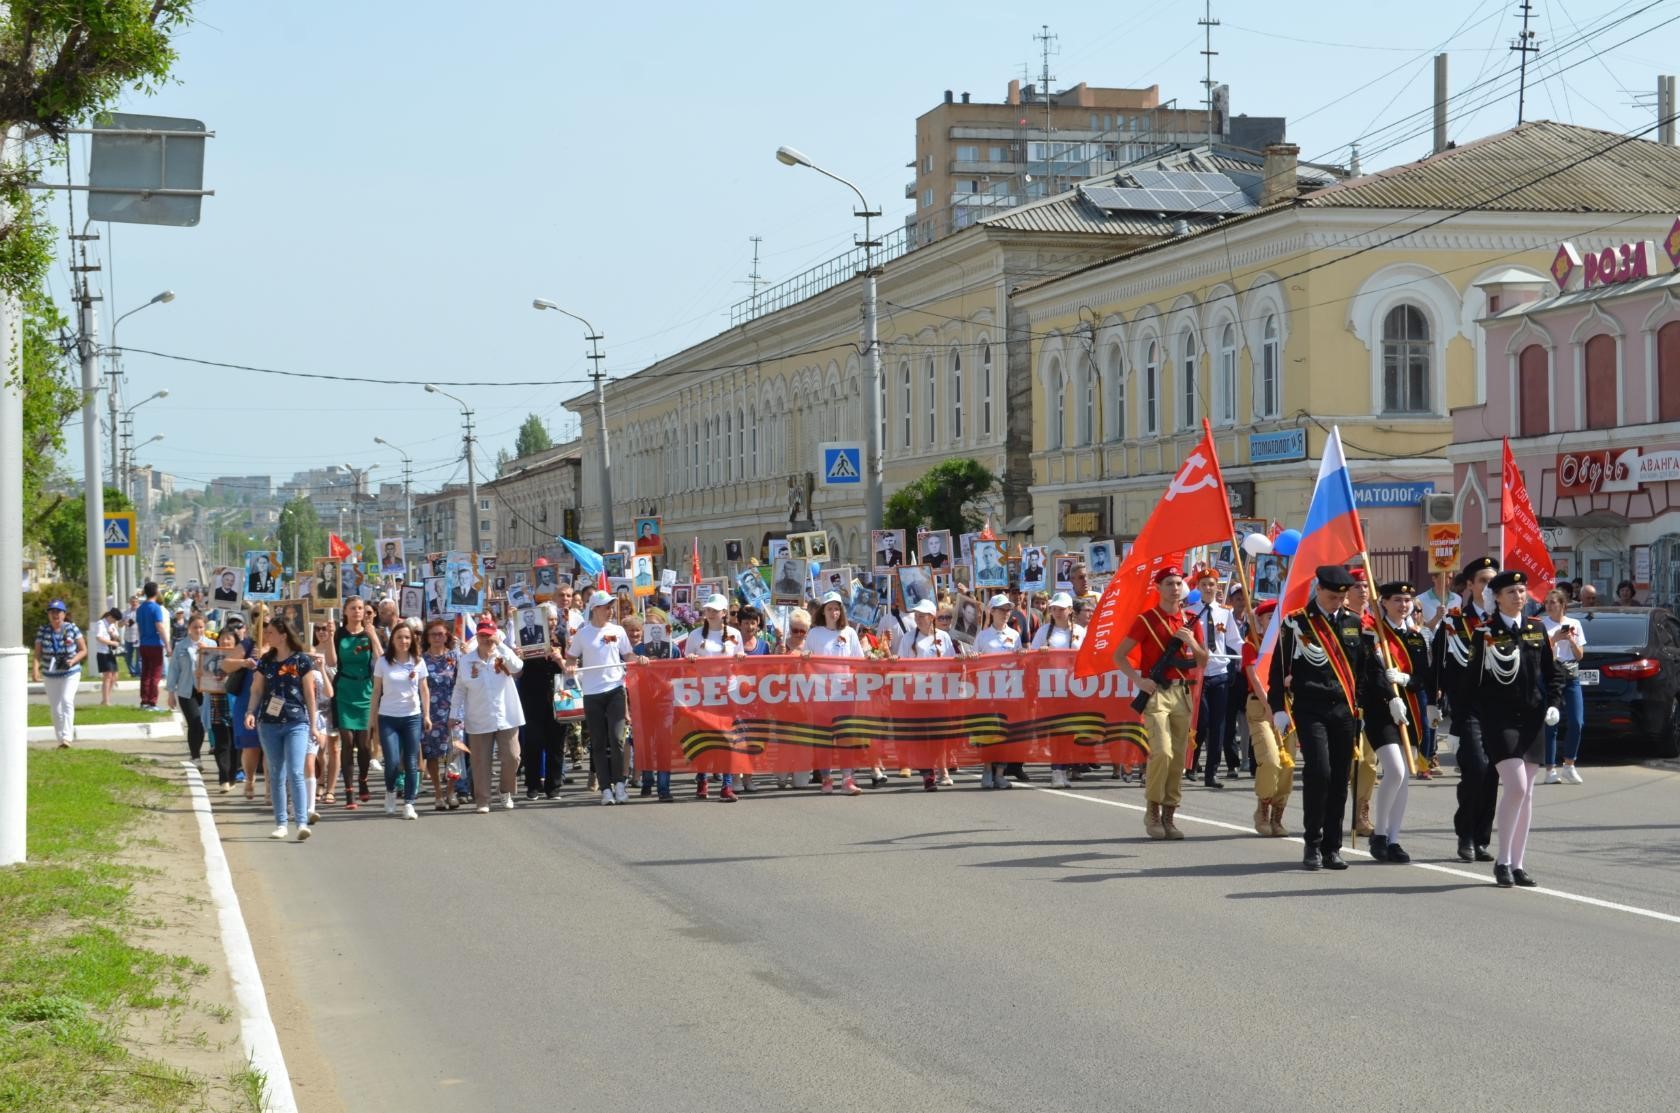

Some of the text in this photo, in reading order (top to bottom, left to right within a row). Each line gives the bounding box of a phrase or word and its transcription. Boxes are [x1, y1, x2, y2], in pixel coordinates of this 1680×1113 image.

[1584, 240, 1652, 289] РОЗА
[1560, 450, 1624, 493] Обувь
[1354, 488, 1414, 502] МАТОЛОГ
[671, 662, 1142, 707] БЕССМЕРТНЫЙ ПОЛ
